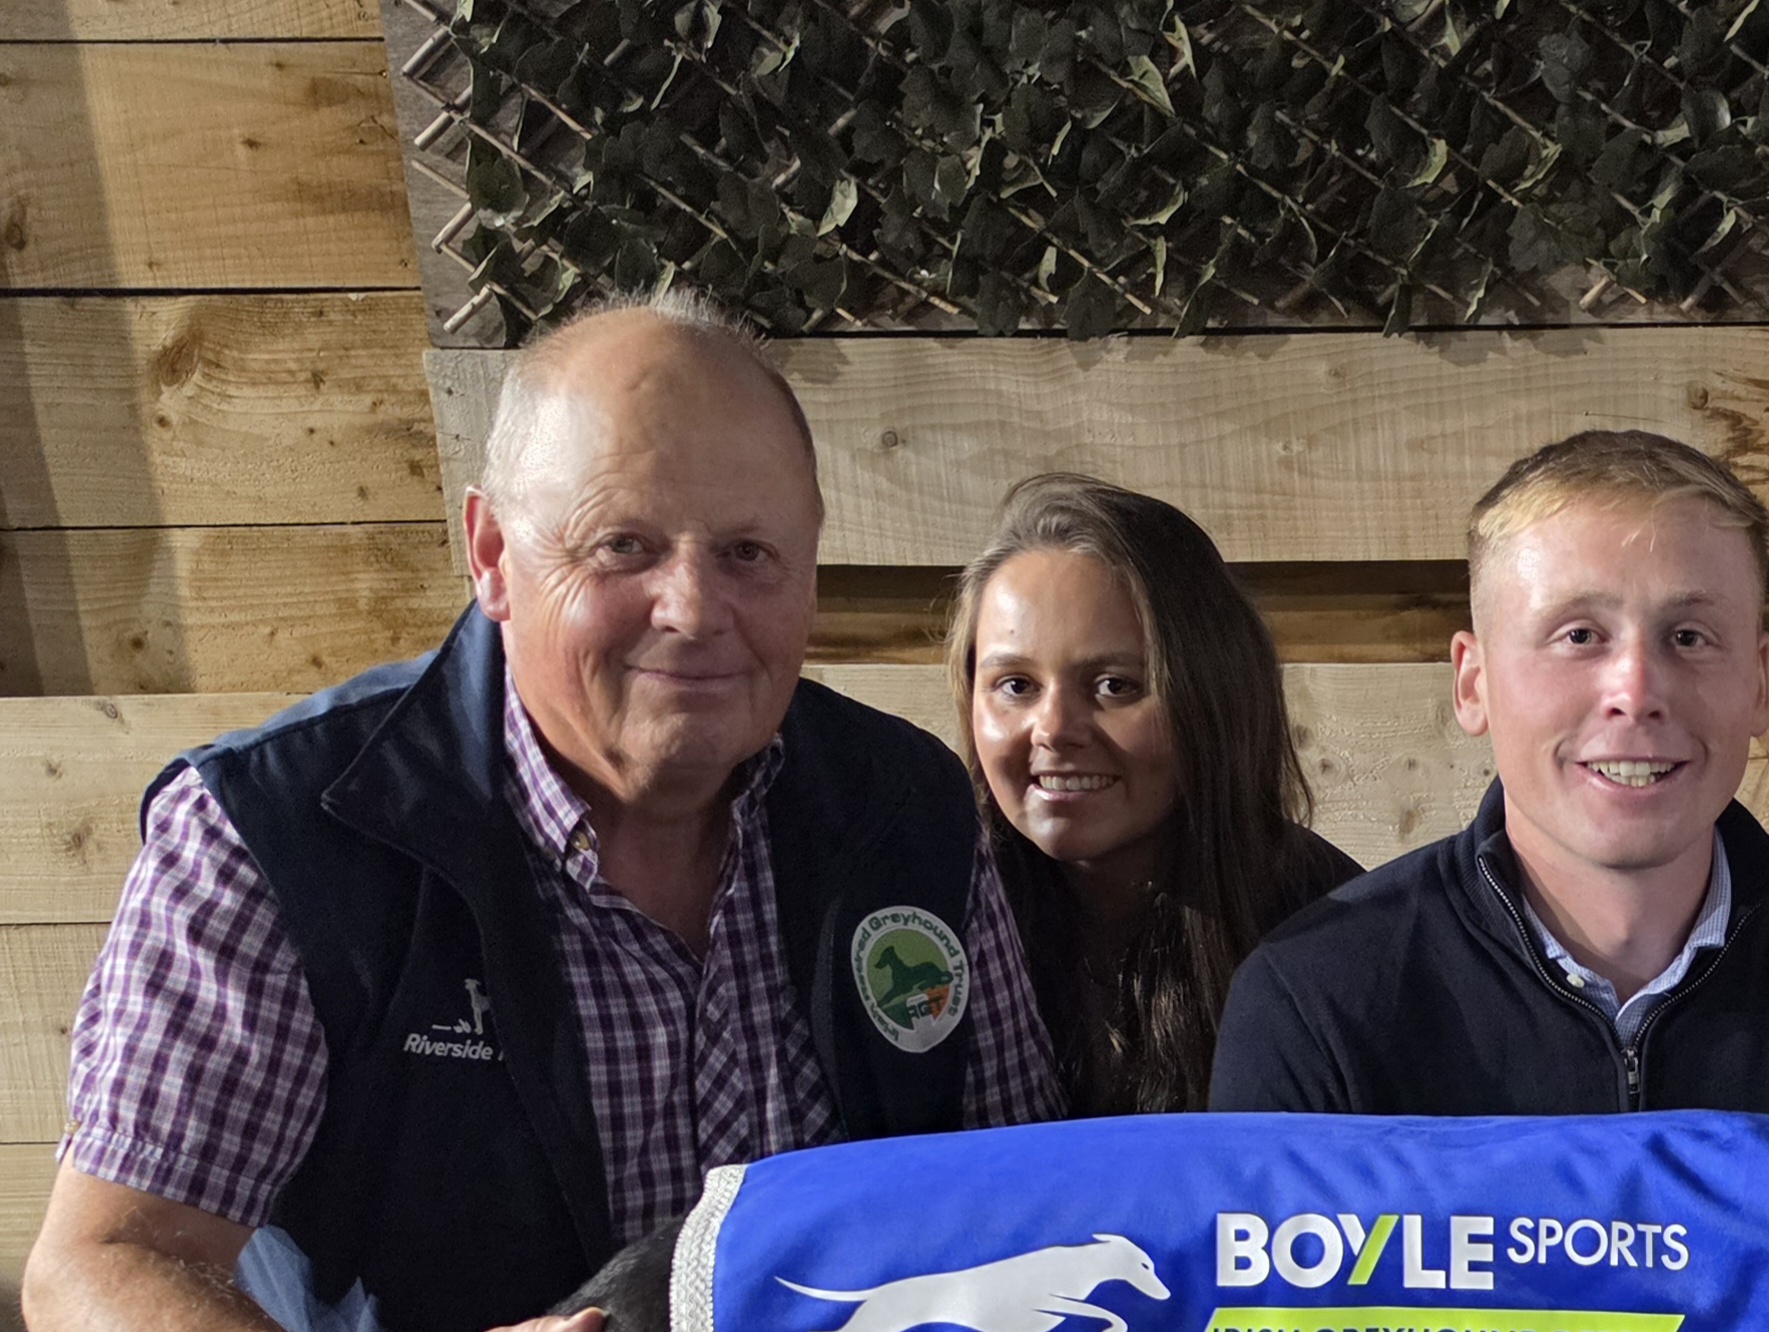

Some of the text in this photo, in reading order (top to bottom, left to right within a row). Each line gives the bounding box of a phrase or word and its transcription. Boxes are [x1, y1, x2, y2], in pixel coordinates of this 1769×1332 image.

[404, 1033, 494, 1060] Riverside
[1216, 1212, 1690, 1290] BOYLE SPORTS
